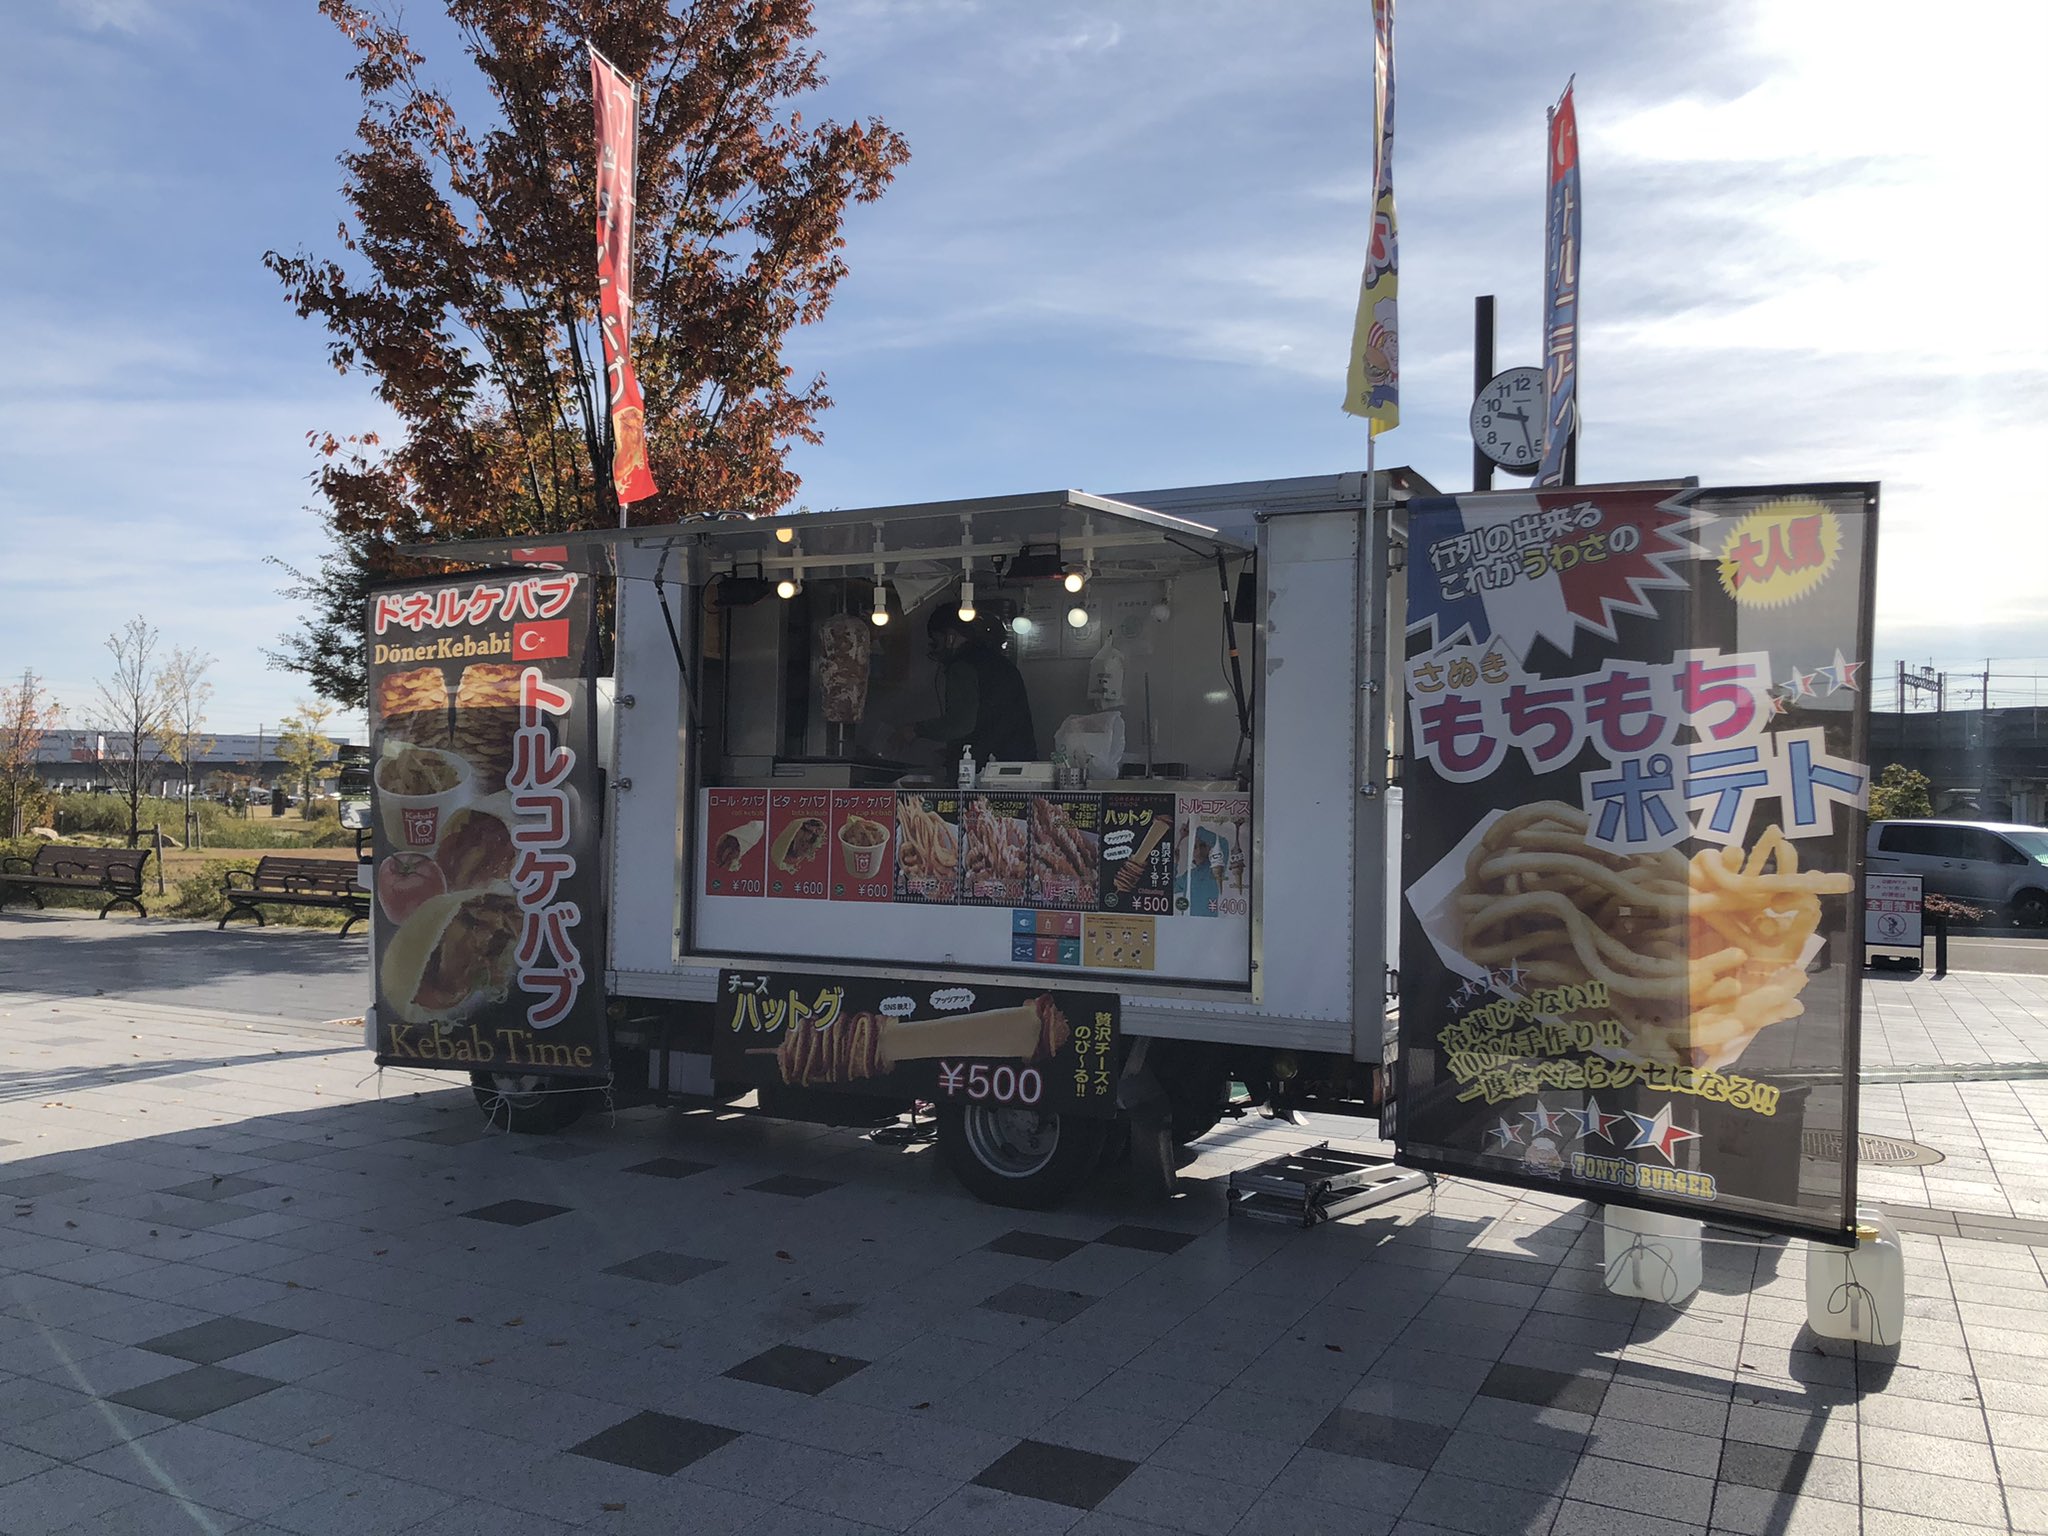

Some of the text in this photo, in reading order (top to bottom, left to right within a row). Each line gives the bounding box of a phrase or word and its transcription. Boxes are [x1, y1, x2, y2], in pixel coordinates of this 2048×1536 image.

[1497, 384, 1511, 397] 11
[1513, 378, 1530, 391] 12
[1485, 399, 1501, 412] 10
[1481, 416, 1491, 428] 9
[1487, 431, 1497, 444] 8
[1500, 442, 1512, 455] 7
[1517, 445, 1526, 459] 6
[1428, 500, 1603, 572] 行列の出来る
[1730, 514, 1825, 589] 大人気
[1438, 523, 1640, 601] これがうわさの
[375, 572, 578, 635] ドネルケバブ
[1413, 651, 1511, 693] さぬき
[1418, 657, 1759, 775] もちもち
[1591, 739, 1866, 843] ポテト
[834, 796, 892, 808] カップ・ケバブ
[1179, 798, 1250, 815] トルコアイス
[405, 811, 436, 820] Kebab
[1104, 809, 1153, 826] ハットグ
[506, 666, 584, 1029] トルコケバブ
[732, 880, 761, 893] ¥700
[794, 882, 824, 895] ¥600
[858, 884, 888, 897] ¥600
[1132, 896, 1169, 912] ¥500
[1208, 898, 1247, 915] ¥400
[1867, 900, 1920, 912] 全面禁止
[727, 974, 769, 995] チーズ
[731, 986, 844, 1033] ハットグ
[388, 1023, 593, 1068] Kebab Time
[938, 1060, 1042, 1104] ¥500
[1573, 1153, 1715, 1199] TONY'S BURGER
